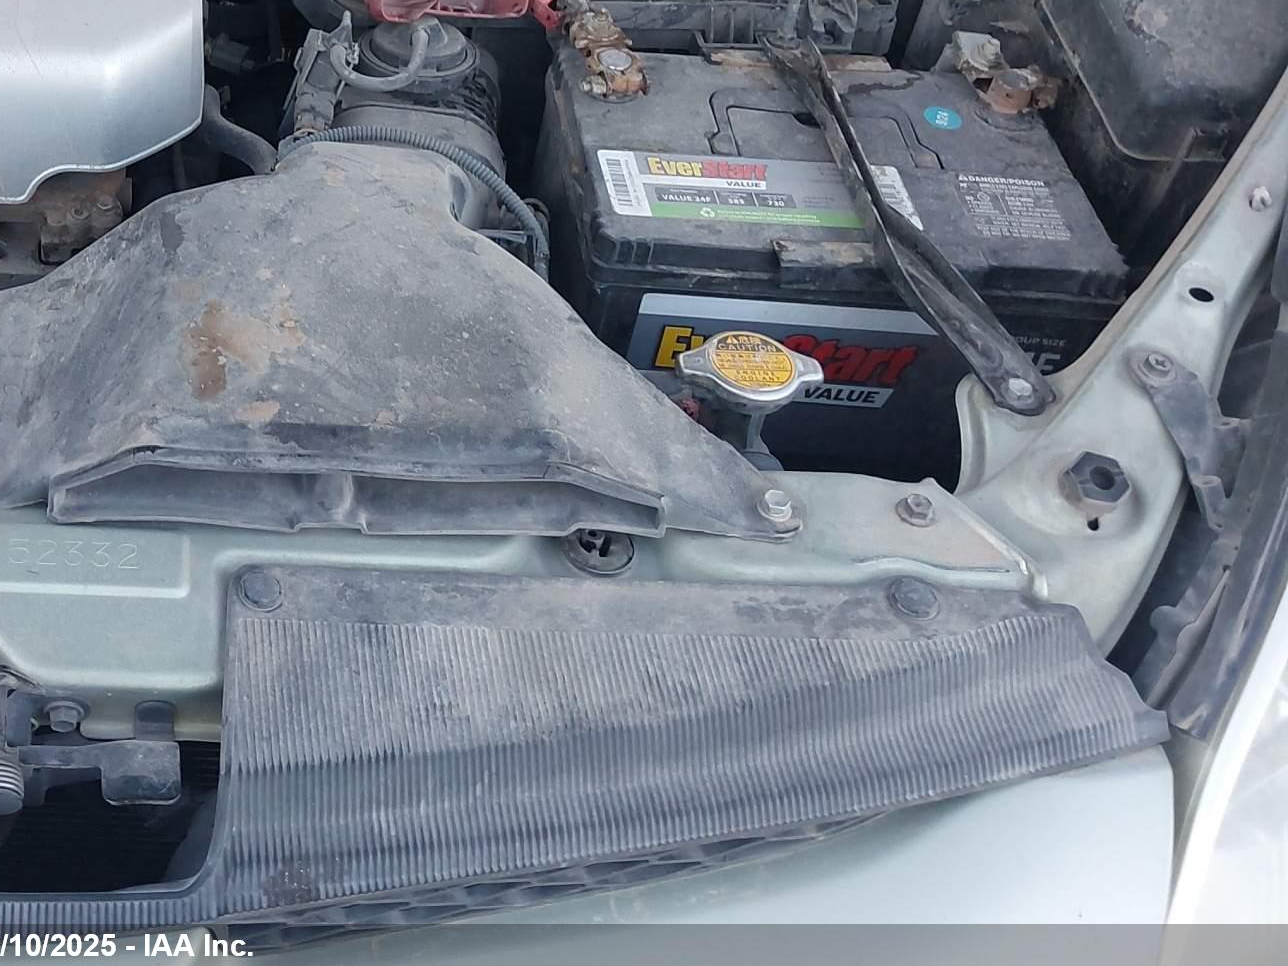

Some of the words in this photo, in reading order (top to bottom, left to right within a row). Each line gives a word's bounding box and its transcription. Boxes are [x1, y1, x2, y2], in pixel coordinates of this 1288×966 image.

[647, 156, 768, 180] EverStart
[726, 180, 762, 189] VALUE
[968, 175, 1044, 187] DANGER/POISON
[661, 193, 694, 202] VALUE
[718, 342, 777, 353] CAUTION
[1041, 337, 1068, 347] SIZE
[805, 387, 880, 403] VALUE
[9, 538, 140, 569] 52332
